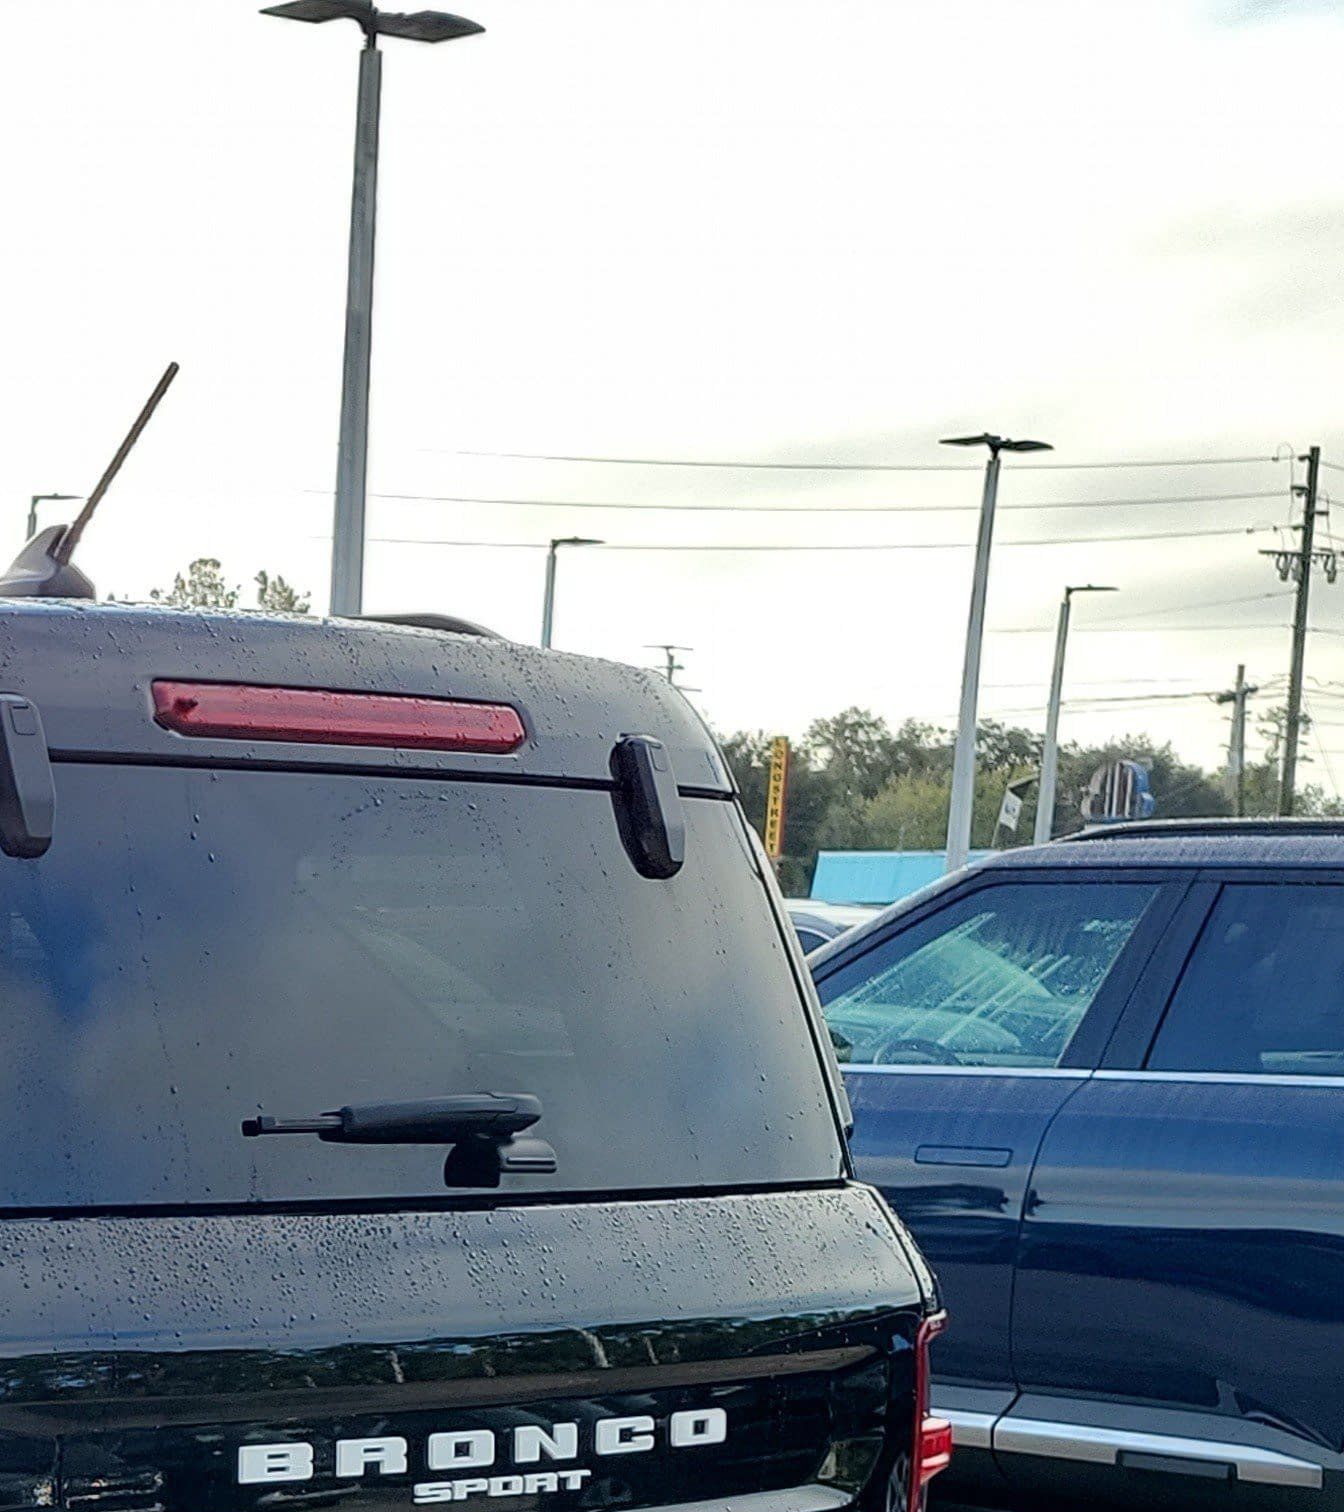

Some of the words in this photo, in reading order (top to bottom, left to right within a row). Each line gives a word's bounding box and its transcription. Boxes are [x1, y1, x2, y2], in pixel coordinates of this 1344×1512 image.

[768, 738, 784, 853] LONGSTREET
[237, 1407, 728, 1485] BRONCO
[414, 1469, 592, 1504] SPORT
